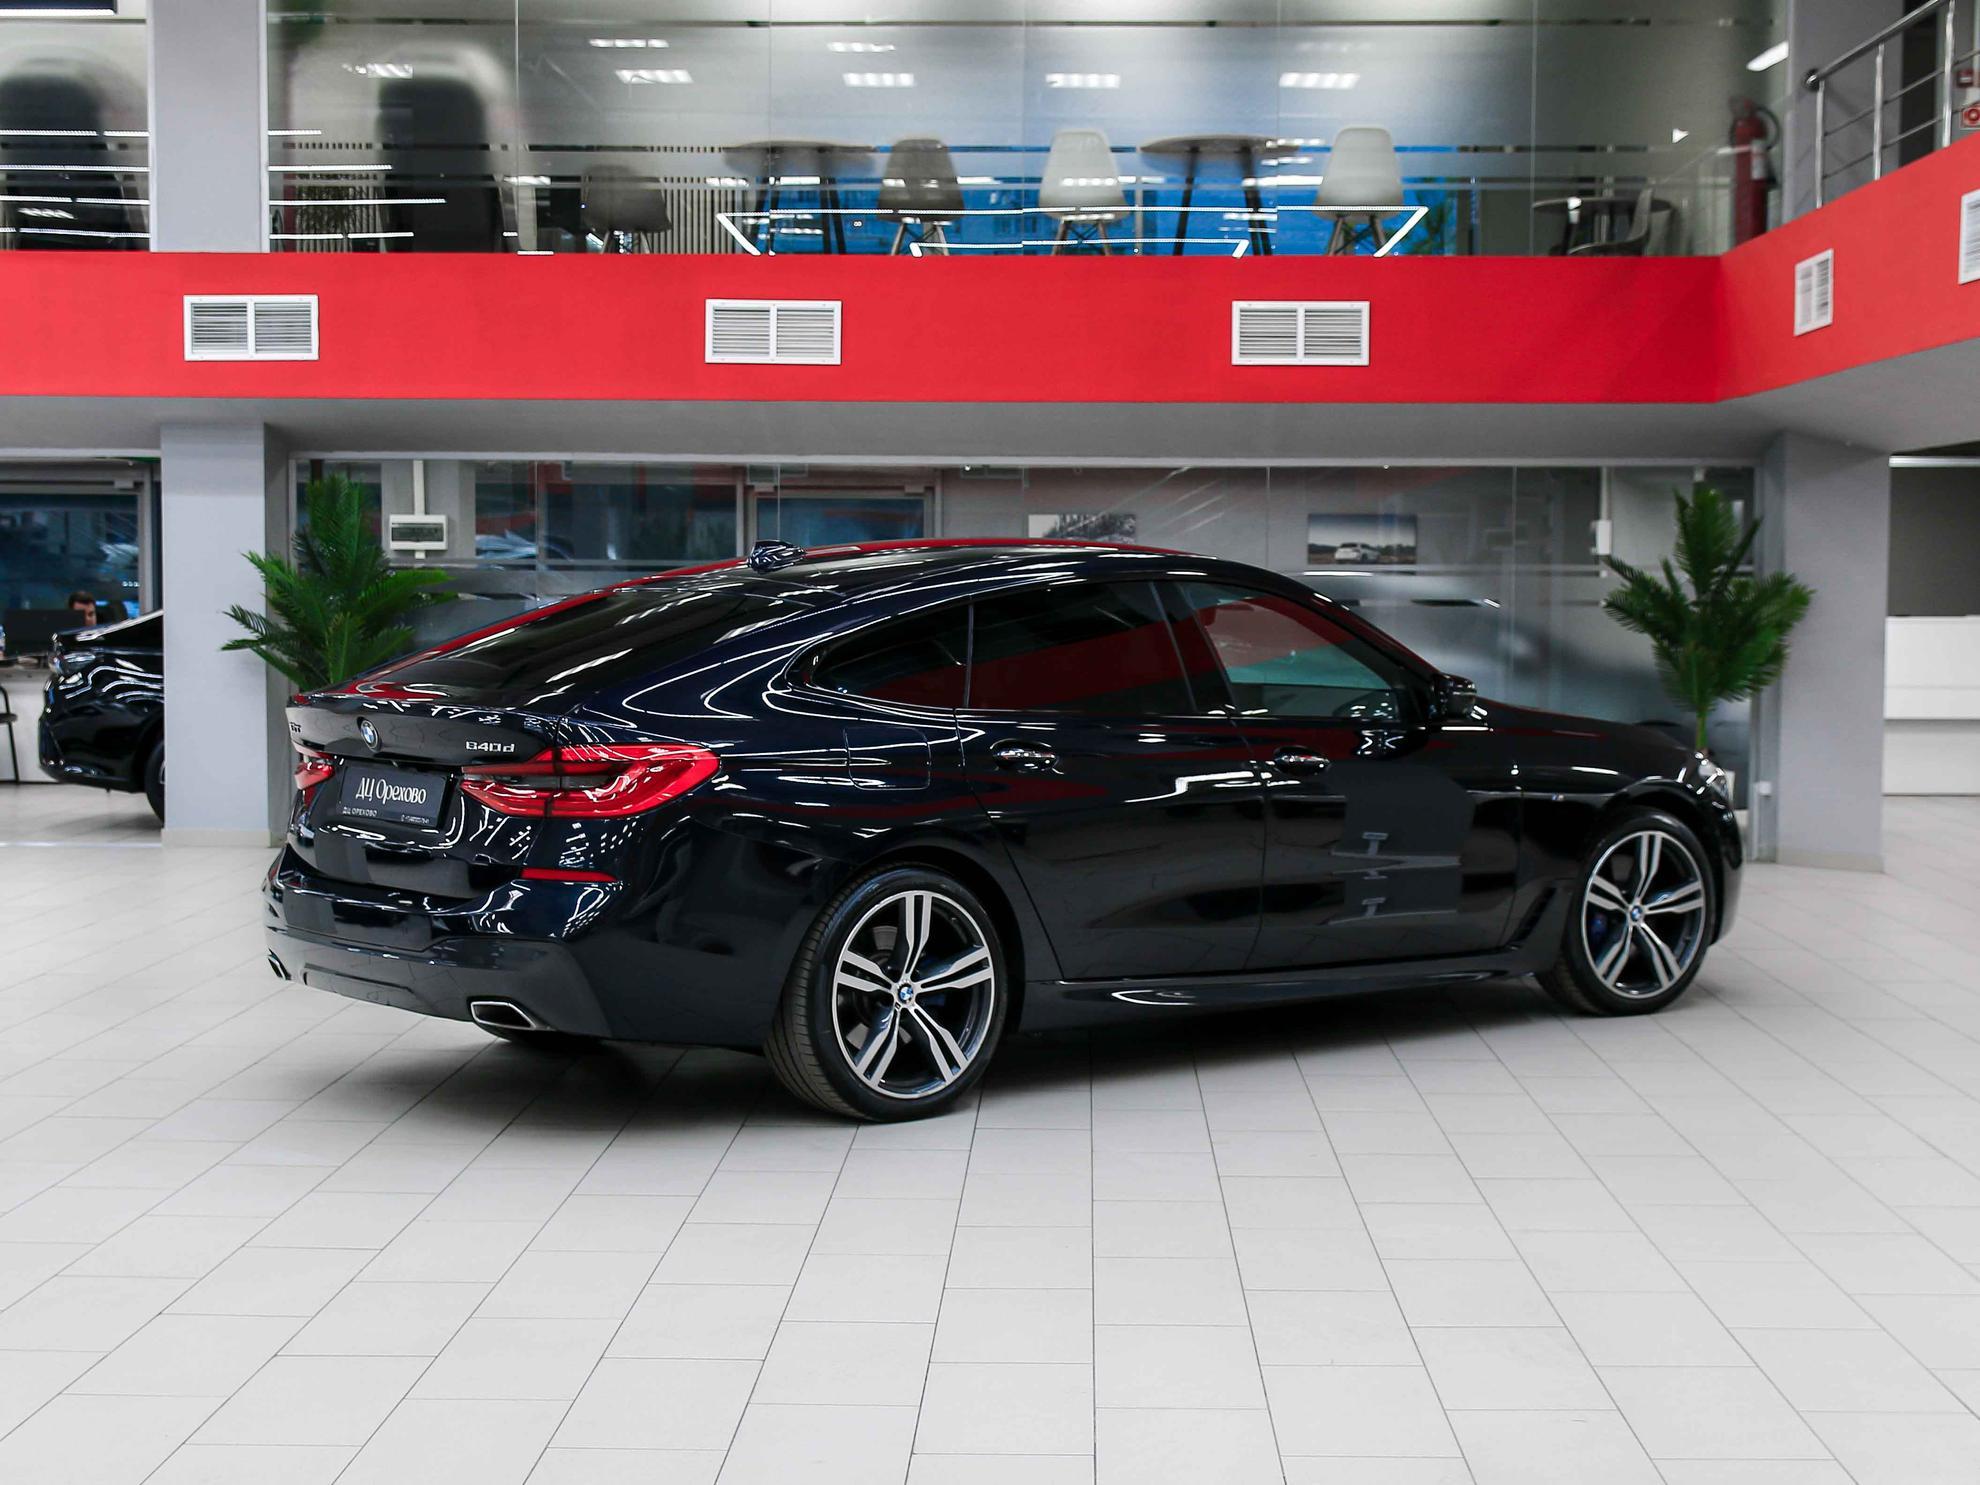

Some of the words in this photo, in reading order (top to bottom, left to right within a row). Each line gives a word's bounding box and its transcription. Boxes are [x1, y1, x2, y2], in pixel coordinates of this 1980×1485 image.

[465, 741, 515, 752] 640d
[355, 777, 375, 802] ДЦ
[375, 778, 427, 805] Орехово
